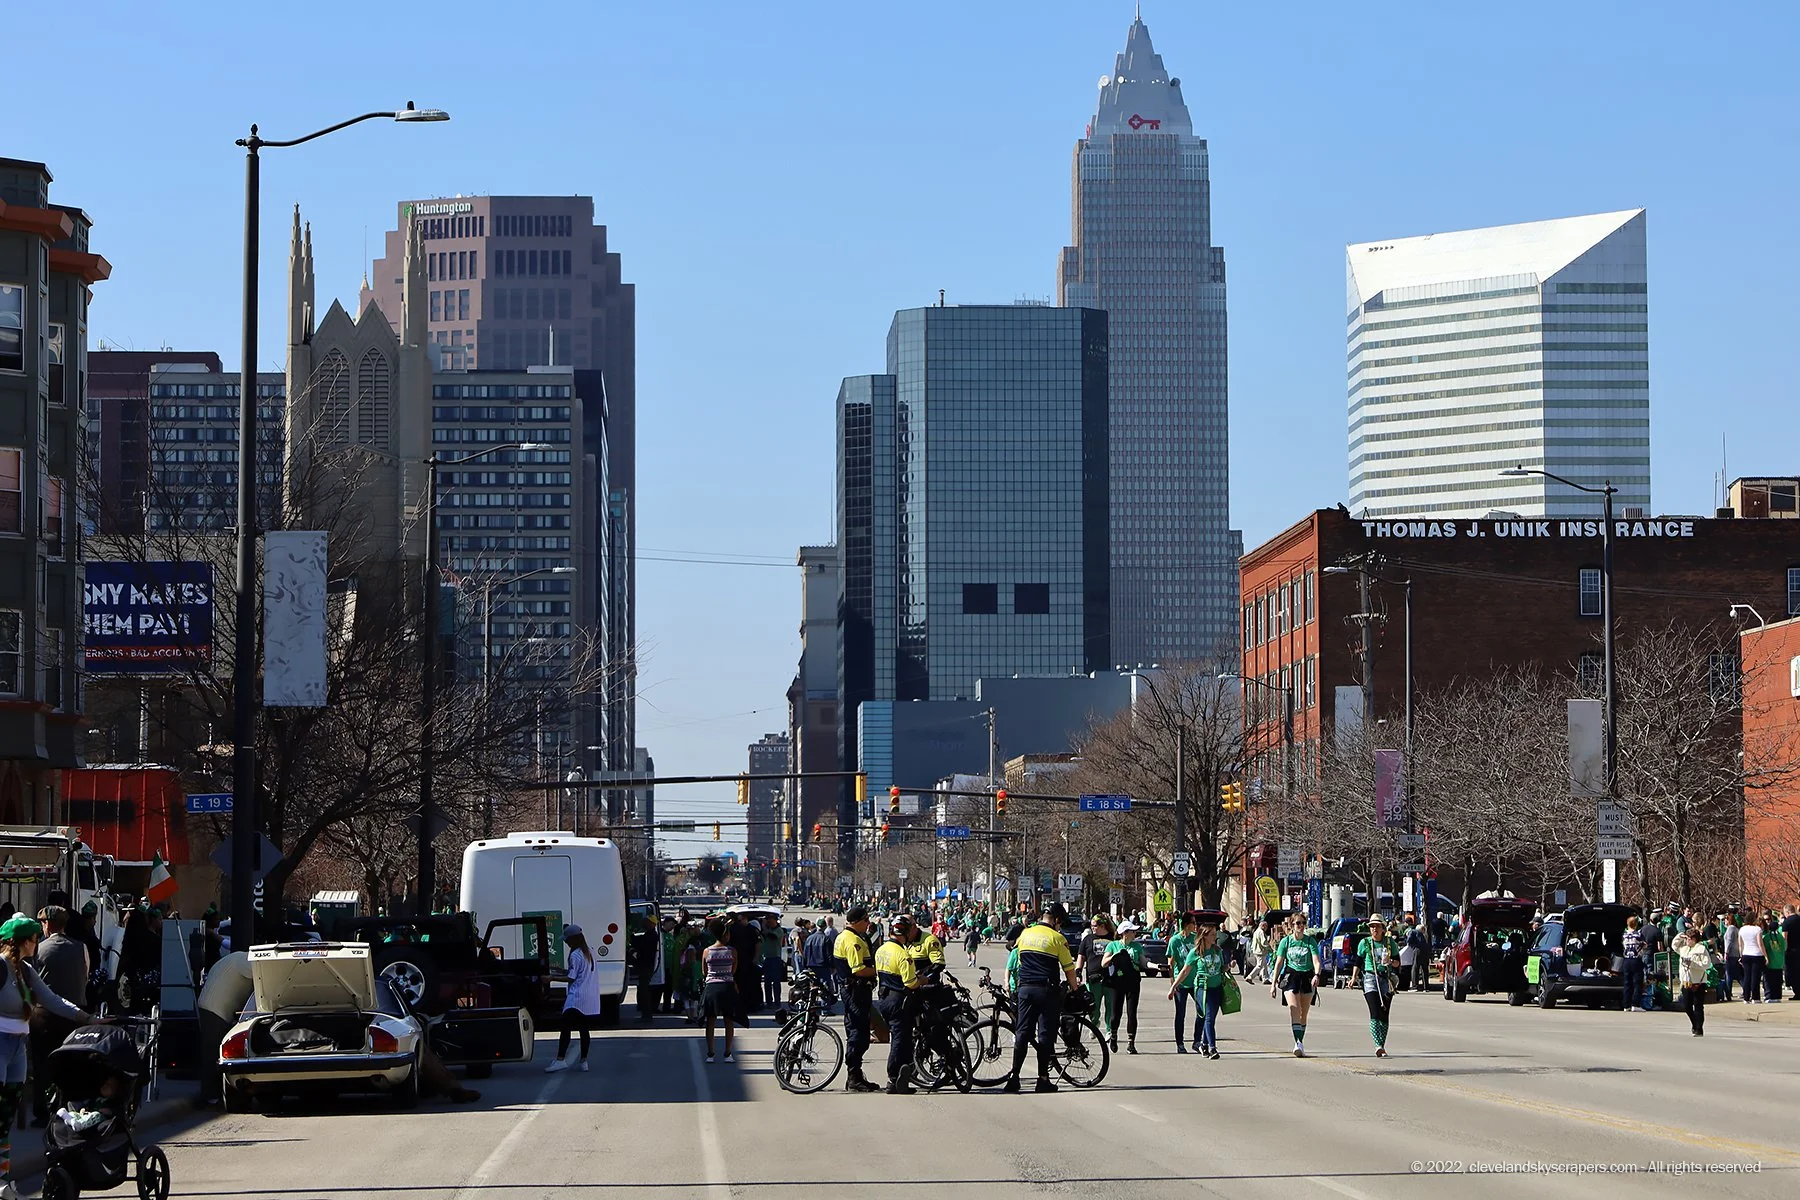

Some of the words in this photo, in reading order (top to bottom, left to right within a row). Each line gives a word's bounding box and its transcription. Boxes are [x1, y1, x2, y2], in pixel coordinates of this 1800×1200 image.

[416, 202, 471, 215] Huntington
[1362, 521, 1457, 538] THOMAS
[1466, 521, 1486, 538] J.
[1494, 521, 1551, 538] UNIK
[130, 583, 208, 605] MAKES
[139, 613, 191, 635] PAY!
[130, 649, 150, 658] BAD
[152, 648, 208, 659] ACCIDNS
[193, 798, 203, 809] E.
[207, 798, 220, 808] 19
[1086, 800, 1095, 809] E.
[1099, 800, 1109, 809] 18
[1113, 800, 1124, 809] St
[1384, 797, 1393, 821] ARTS
[1605, 814, 1624, 822] MUST
[1178, 863, 1185, 872] 6
